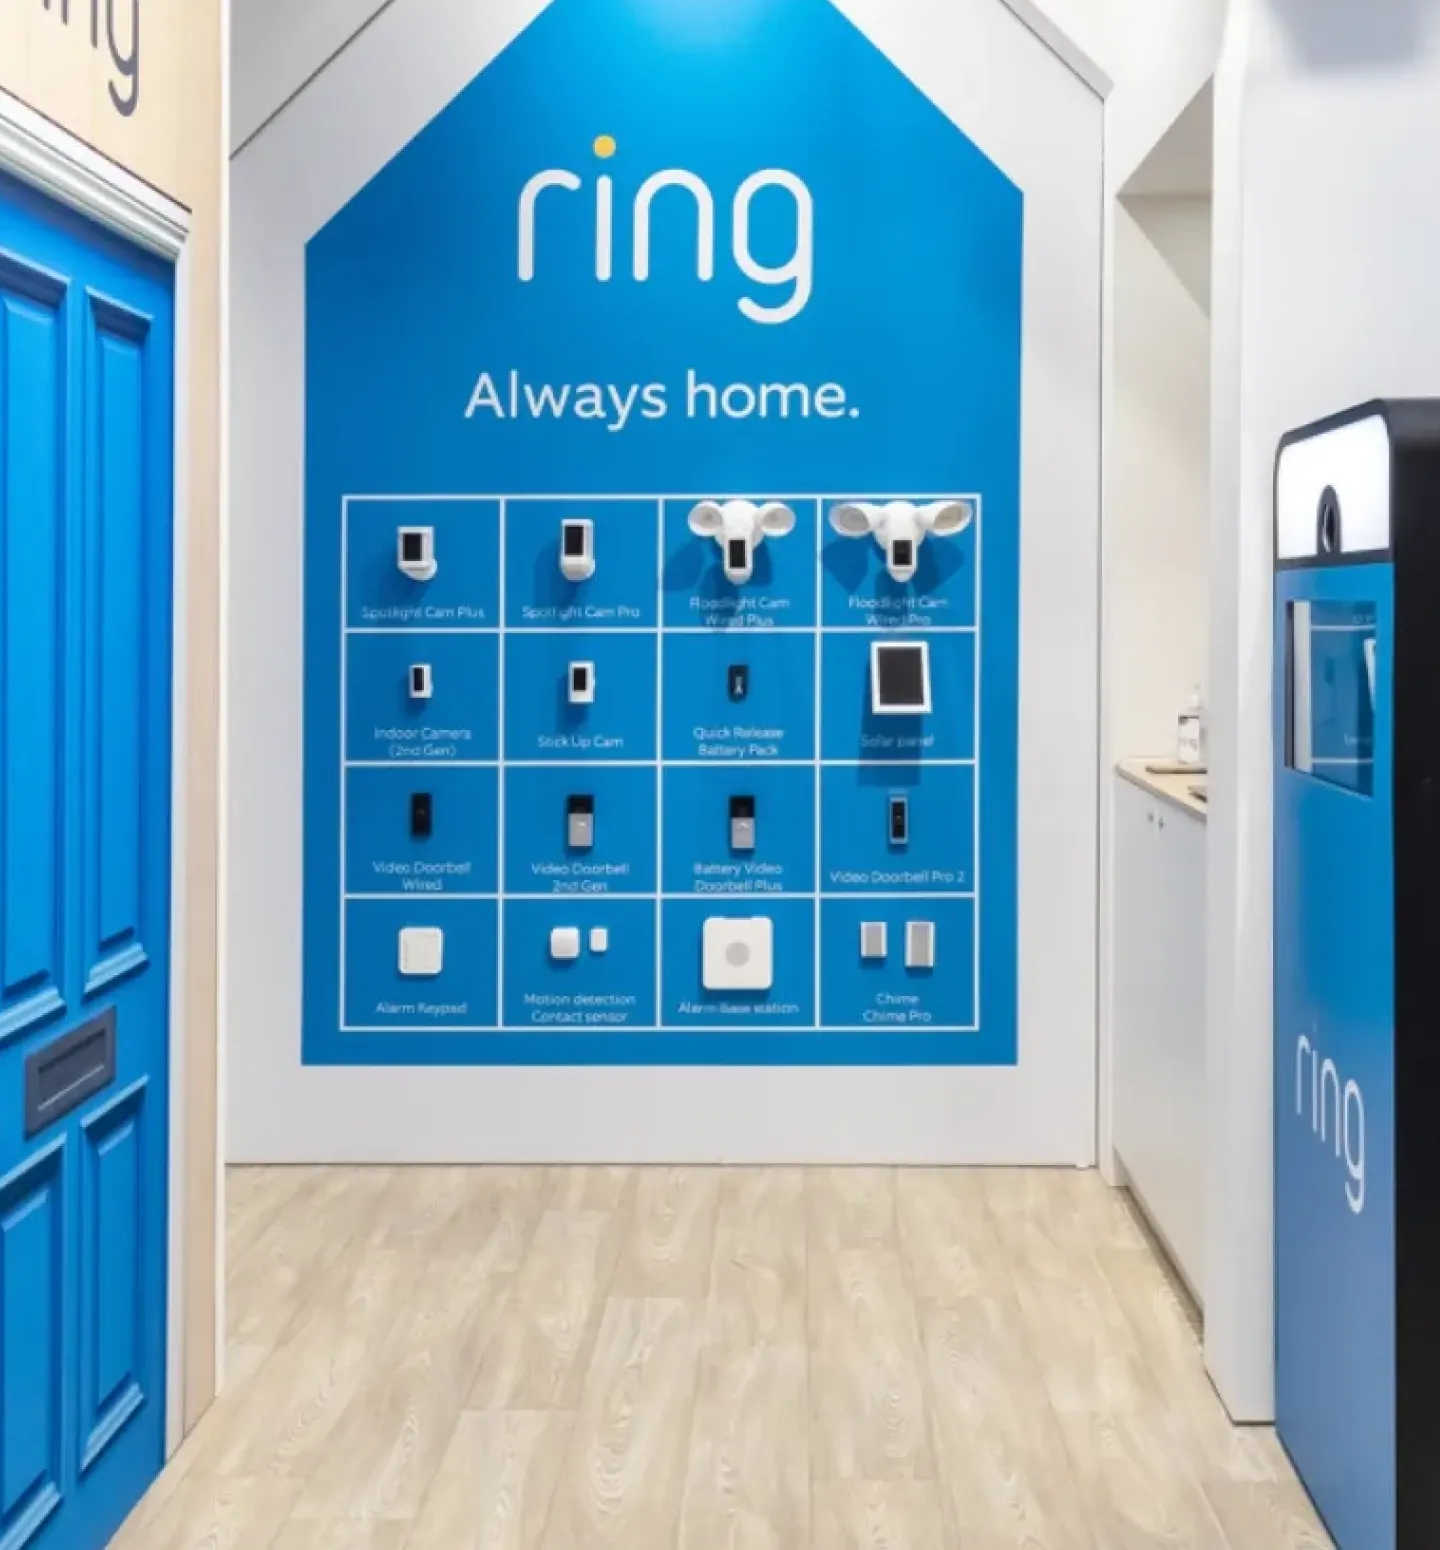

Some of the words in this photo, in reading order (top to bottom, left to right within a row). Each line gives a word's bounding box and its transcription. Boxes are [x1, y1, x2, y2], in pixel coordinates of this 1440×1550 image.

[518, 134, 813, 324] ring
[464, 369, 668, 431] Always
[686, 369, 861, 419] home.
[374, 726, 419, 740] Indoor
[421, 726, 472, 740] Camera
[693, 726, 730, 741] Quick
[538, 735, 568, 748] Stick
[571, 735, 591, 751] Up
[593, 735, 624, 748] Cam
[748, 743, 778, 756] Pack
[372, 860, 410, 874] Video
[413, 860, 471, 874] Doorbell
[531, 862, 569, 876] Video
[572, 862, 631, 876] Doorbell
[693, 862, 741, 877] Battery
[744, 862, 783, 876] Video
[401, 877, 444, 891] Wired
[829, 870, 868, 884] Video
[871, 870, 929, 884] Doorbell
[931, 870, 954, 883] Pro
[956, 870, 966, 883] 2
[581, 879, 608, 893] Gen
[693, 878, 752, 892] Doorbell
[755, 878, 784, 892] Plus
[524, 992, 570, 1006] Motion
[573, 992, 636, 1006] detection
[875, 992, 920, 1006] Chime
[376, 1001, 416, 1014] Alarm
[531, 1010, 582, 1024] Contact
[584, 1011, 628, 1024] sensor
[862, 1010, 906, 1024] Chime
[908, 1010, 932, 1023] Pro
[1295, 1034, 1365, 1214] ring
